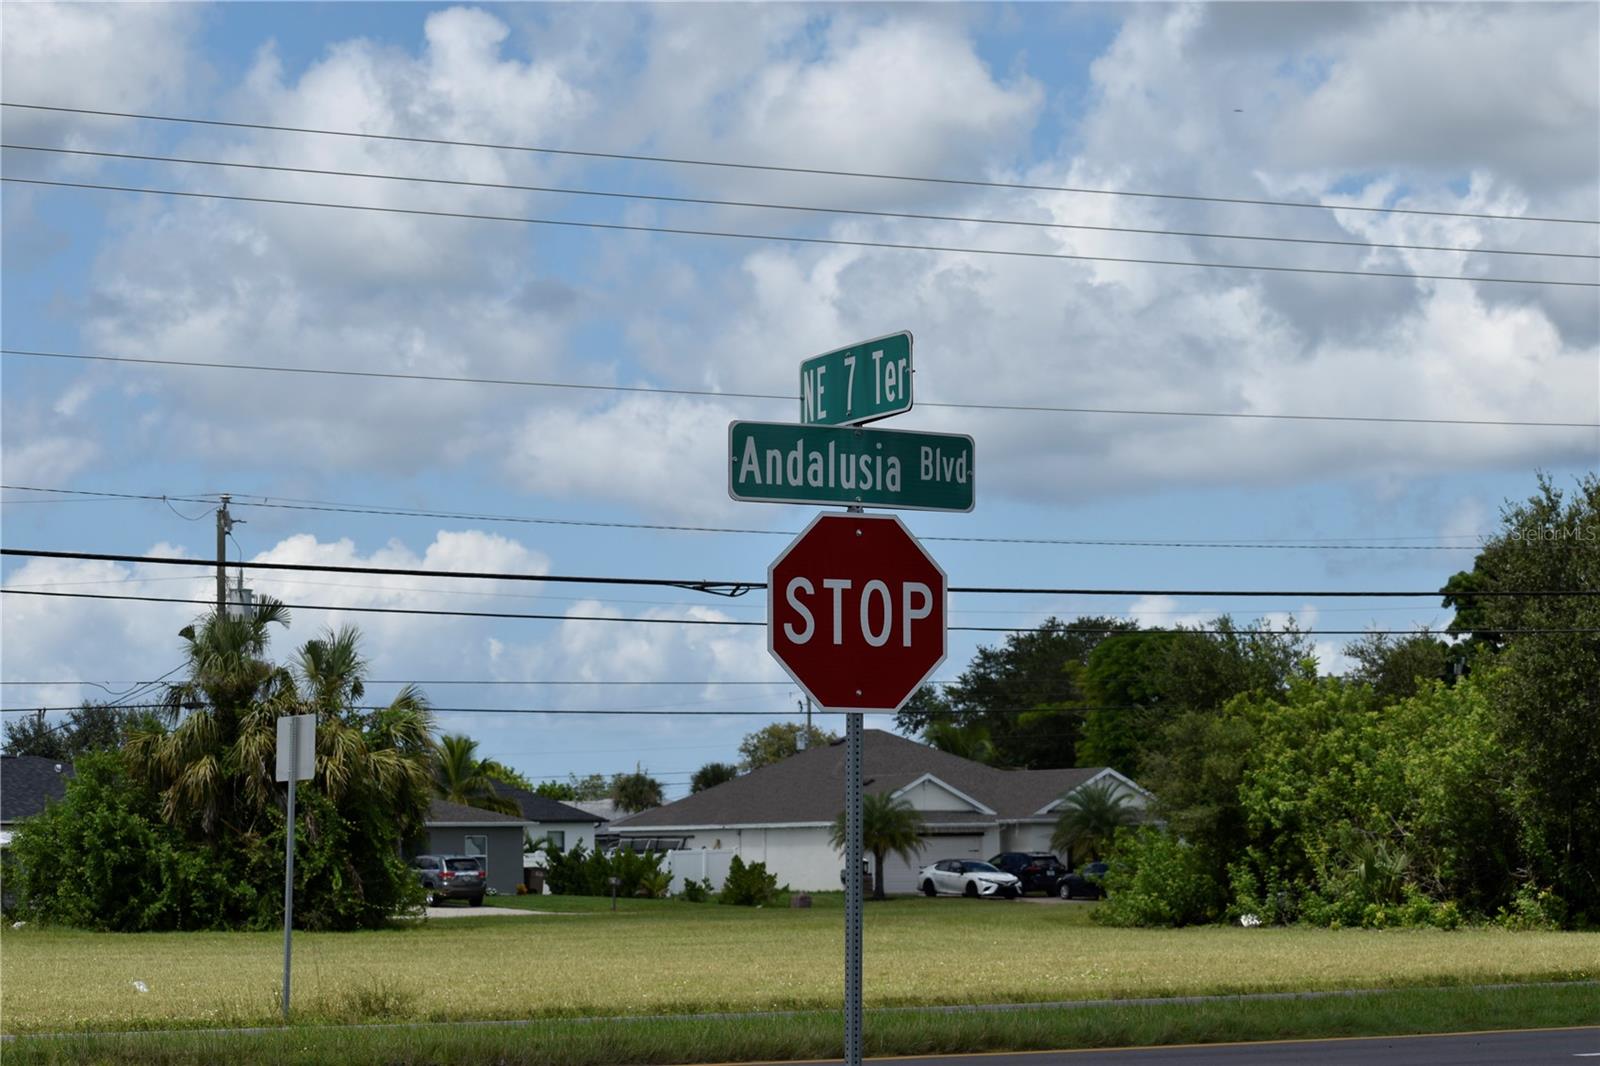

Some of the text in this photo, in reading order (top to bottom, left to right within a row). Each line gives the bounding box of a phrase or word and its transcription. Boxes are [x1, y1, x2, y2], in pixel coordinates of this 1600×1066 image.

[804, 350, 906, 423] NE 7 Ter
[739, 436, 967, 492] Andalusia Blvd
[783, 577, 933, 648] STOP
